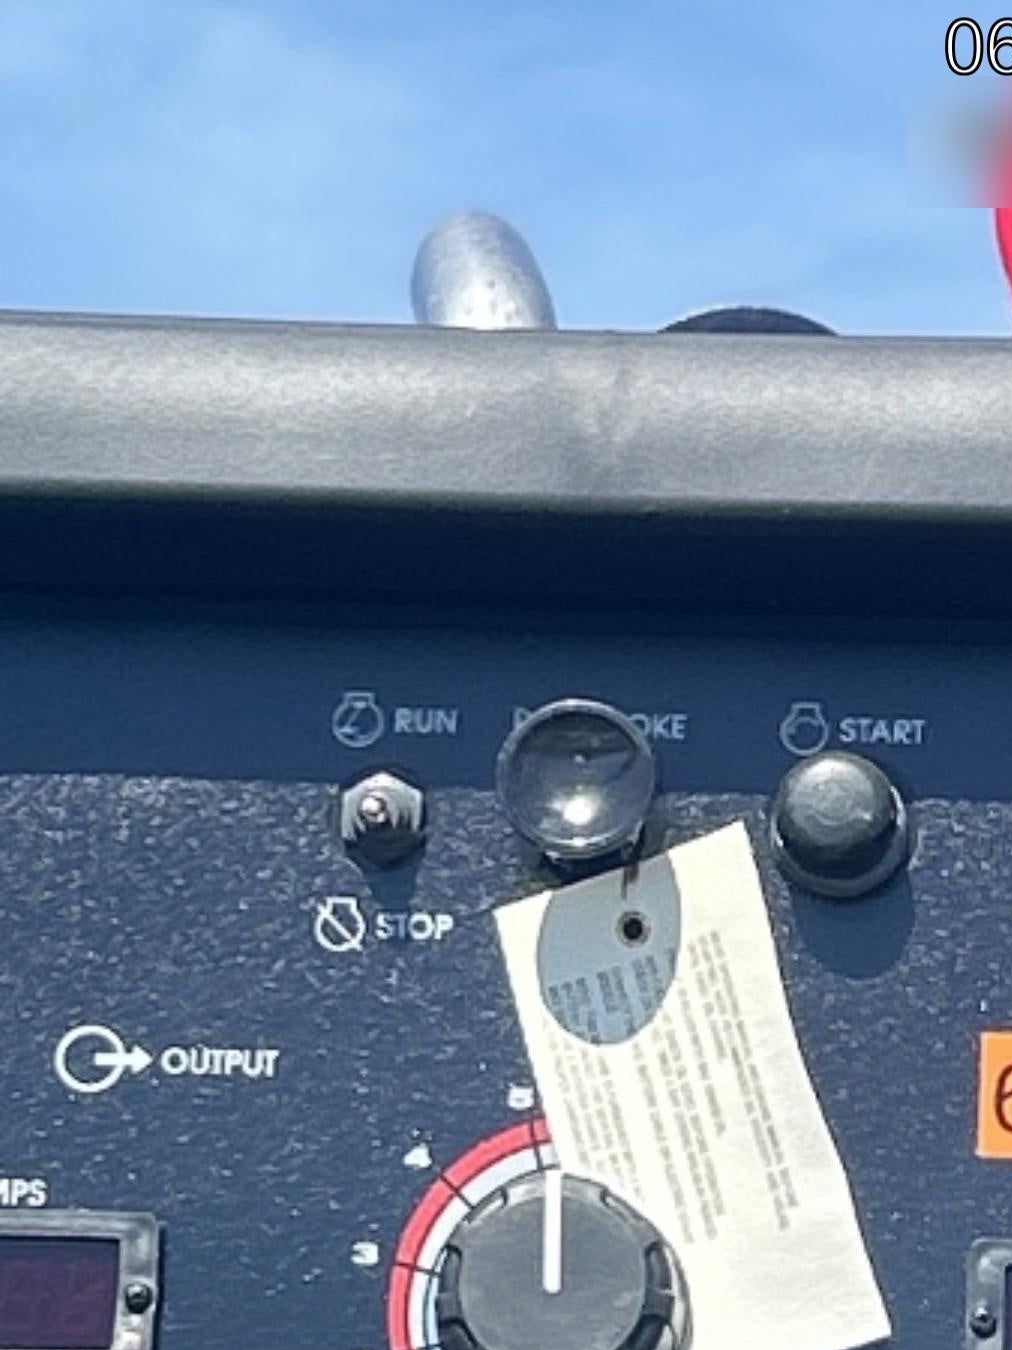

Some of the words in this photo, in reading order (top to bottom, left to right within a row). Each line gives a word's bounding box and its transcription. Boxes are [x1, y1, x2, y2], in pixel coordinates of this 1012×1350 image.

[394, 708, 457, 735] RUN
[839, 718, 925, 745] START
[375, 912, 454, 940] STOP
[160, 1046, 279, 1077] OUTPUT
[351, 1242, 379, 1265] 3
